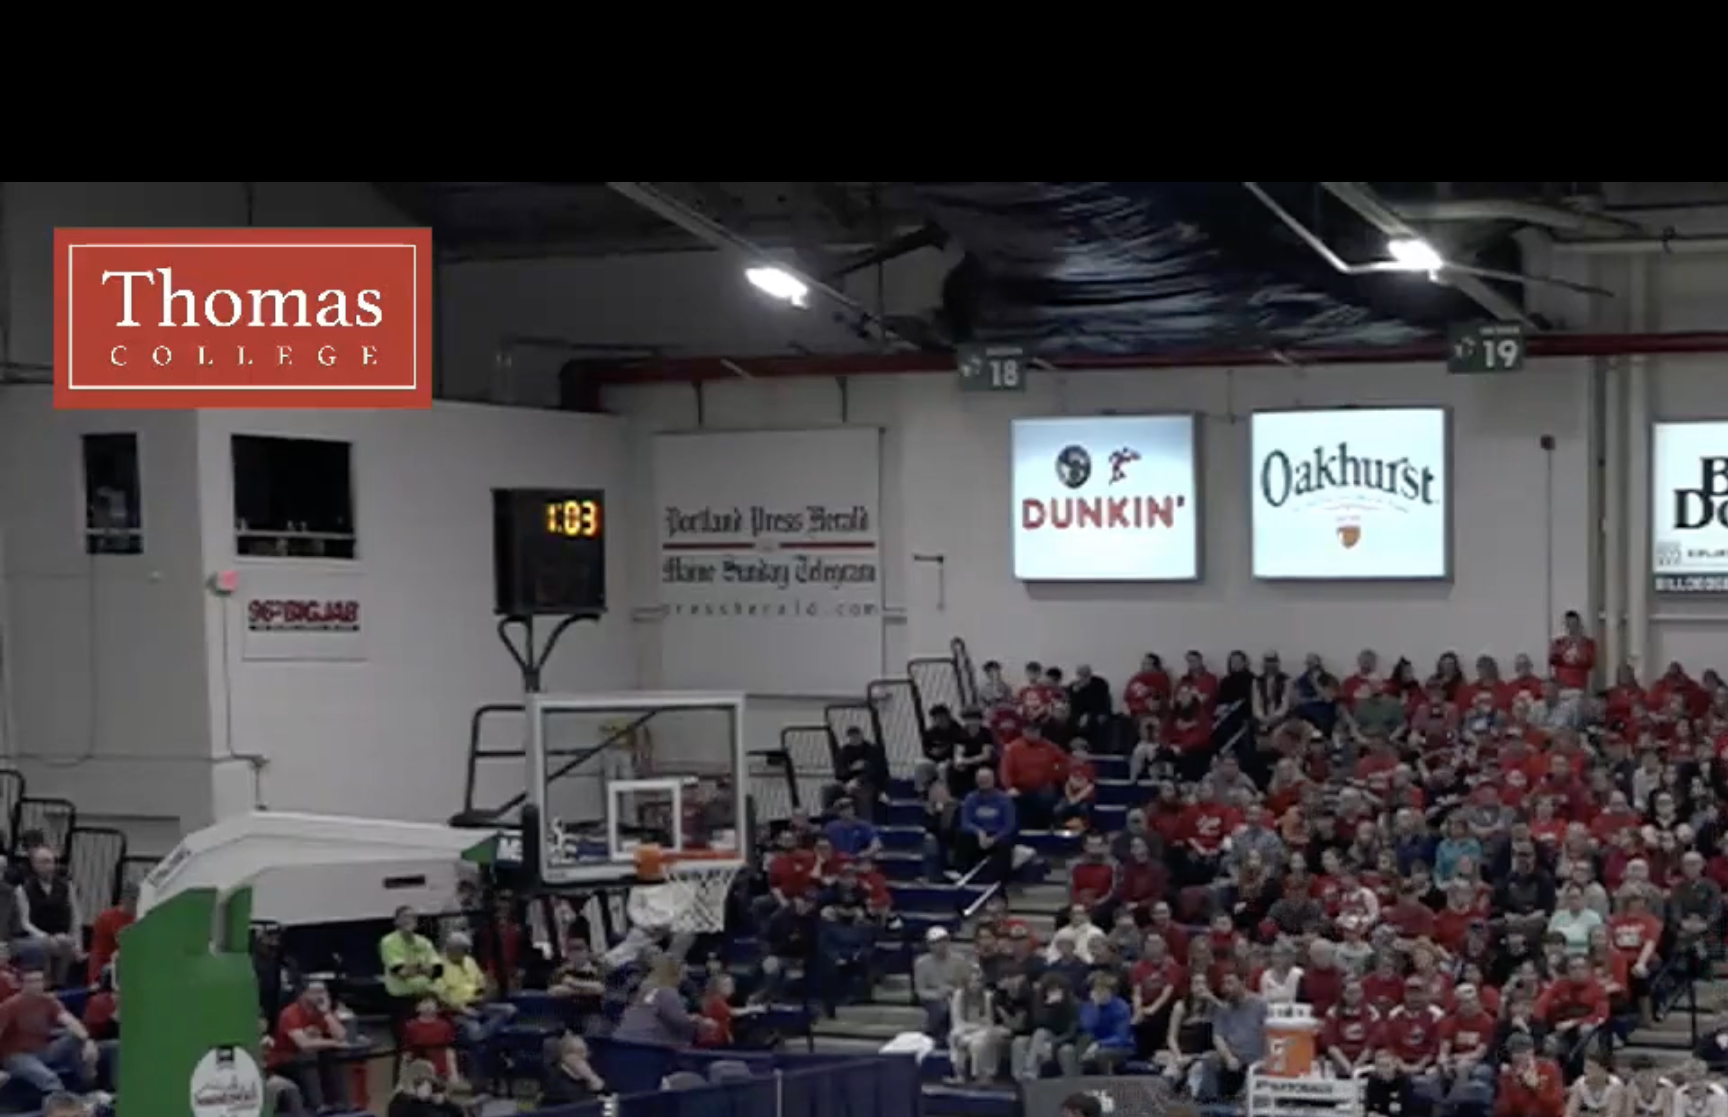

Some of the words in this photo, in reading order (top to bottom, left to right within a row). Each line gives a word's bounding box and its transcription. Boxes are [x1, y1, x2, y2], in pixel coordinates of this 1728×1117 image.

[1483, 339, 1518, 368] 19
[990, 359, 1019, 387] 18
[1260, 441, 1437, 508] Oakhurst
[547, 500, 597, 536] 1:03
[1022, 496, 1185, 530] DUNKIN'
